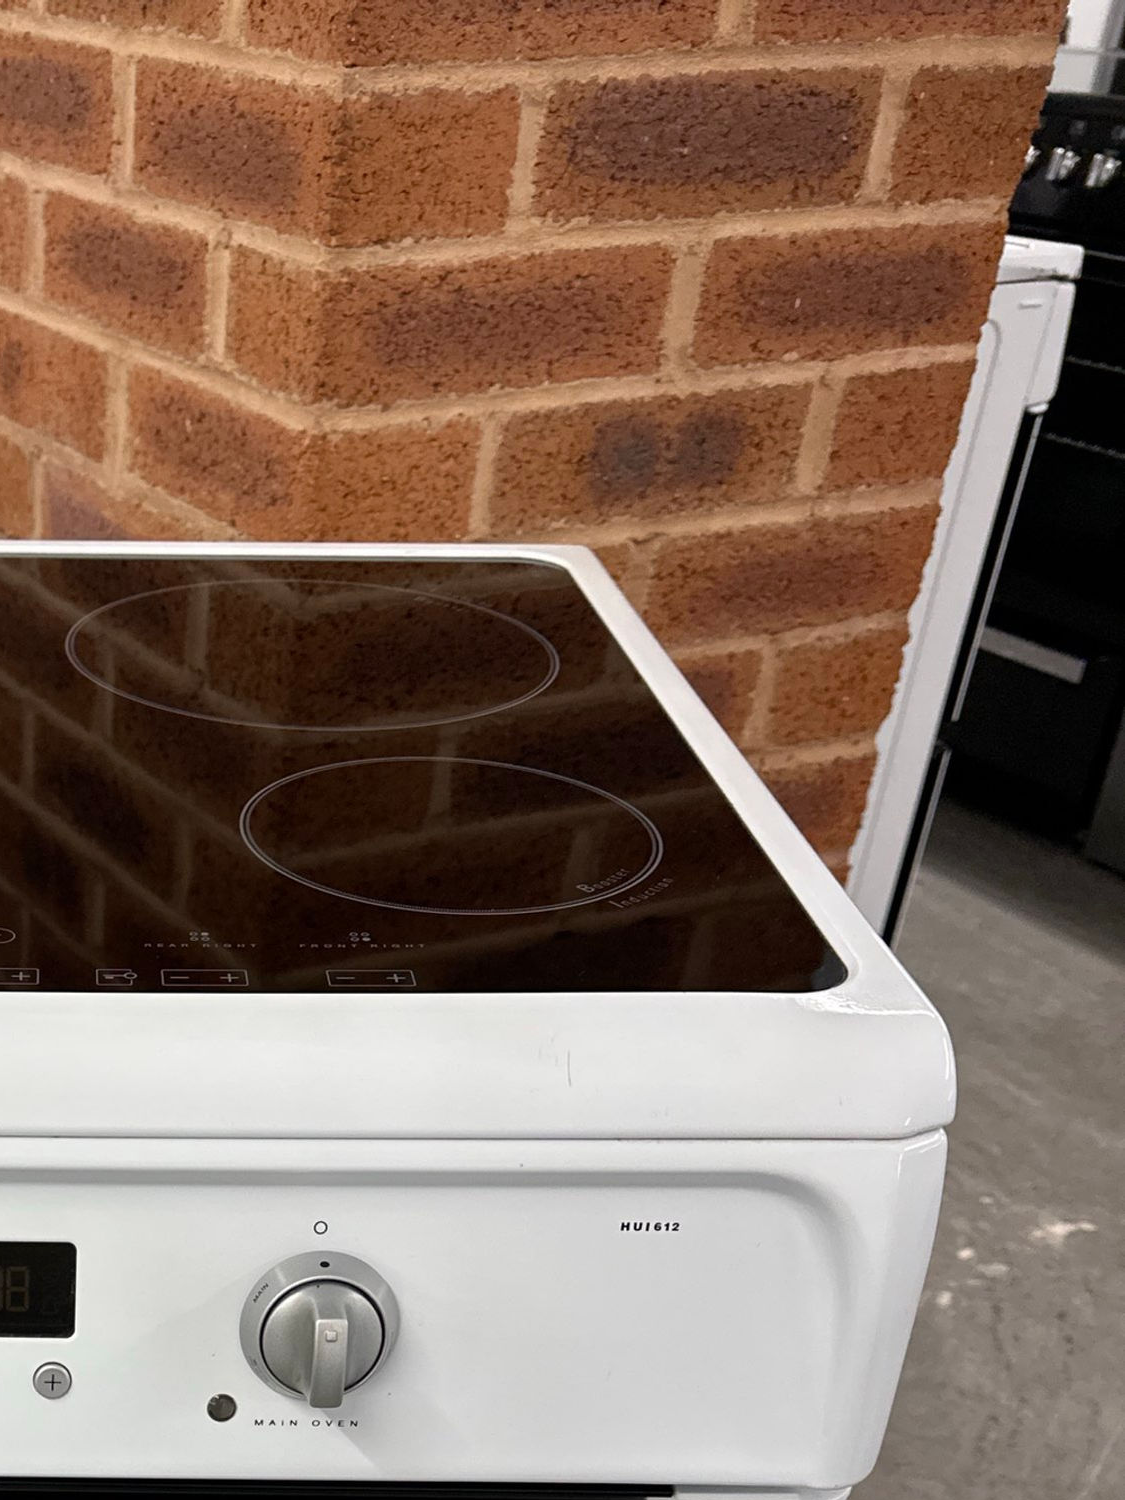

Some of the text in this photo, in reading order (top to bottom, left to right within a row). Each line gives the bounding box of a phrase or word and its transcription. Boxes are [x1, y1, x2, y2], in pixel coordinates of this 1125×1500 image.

[576, 868, 631, 893] Booster
[608, 877, 674, 909] Induction
[620, 1222, 681, 1232] HUI612
[252, 1282, 270, 1304] MAIN
[253, 1418, 359, 1428] MAIN OVEN
